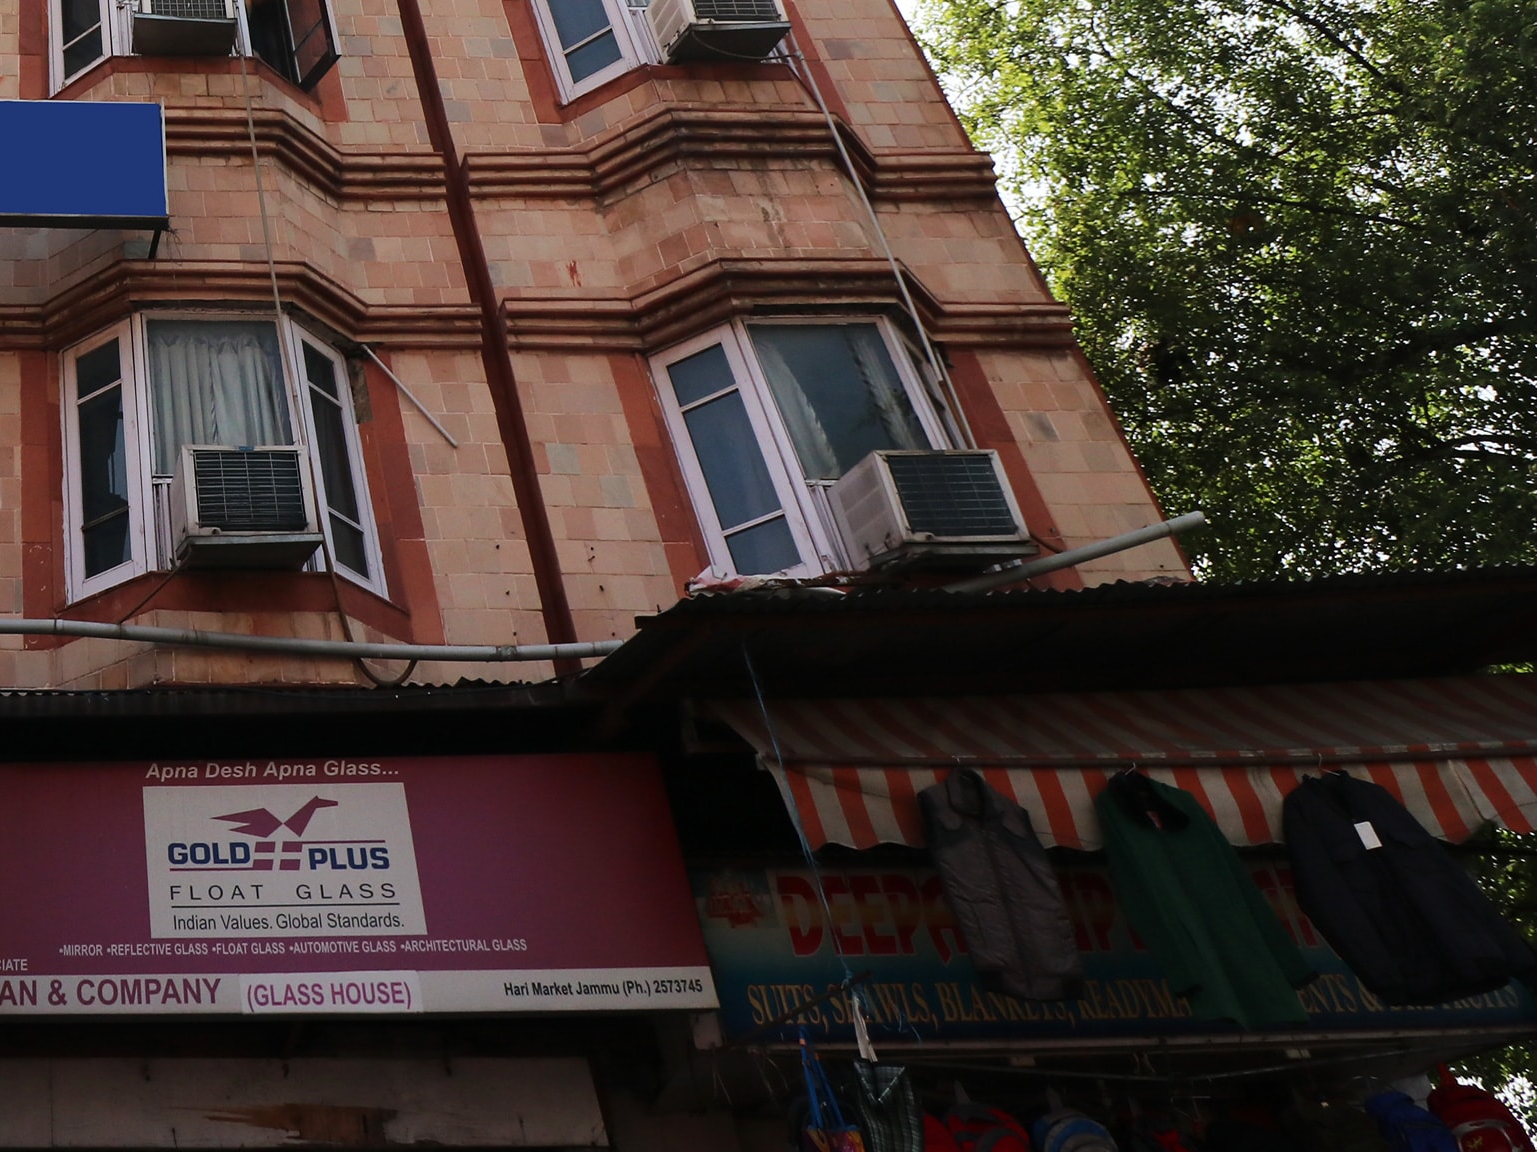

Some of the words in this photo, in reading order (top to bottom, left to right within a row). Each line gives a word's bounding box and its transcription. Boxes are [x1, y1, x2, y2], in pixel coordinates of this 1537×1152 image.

[145, 762, 199, 782] Apna
[204, 762, 257, 779] Desh
[263, 760, 316, 780] Apna
[167, 842, 251, 865] GOLD
[308, 847, 390, 870] PLUS
[169, 885, 264, 901] FLOAT
[296, 882, 396, 900] GLASS
[173, 914, 216, 930] Indian
[219, 914, 273, 930] Values.
[275, 913, 323, 930] Global
[326, 912, 405, 929] Standards.
[776, 874, 970, 966] DEEPA
[174, 943, 209, 955] GLASS
[251, 942, 286, 954] GLASS
[361, 940, 397, 953] GLASS
[492, 938, 528, 951] GLASS
[47, 979, 68, 1006] &
[76, 978, 222, 1006] COMPANY
[247, 983, 325, 1012] (GLASS
[330, 981, 412, 1010] HOUSE)
[504, 982, 529, 996] Hari
[531, 982, 573, 996] Market
[576, 981, 620, 995] Jammu
[622, 980, 651, 997] (Ph.)
[653, 979, 704, 994] 2573745
